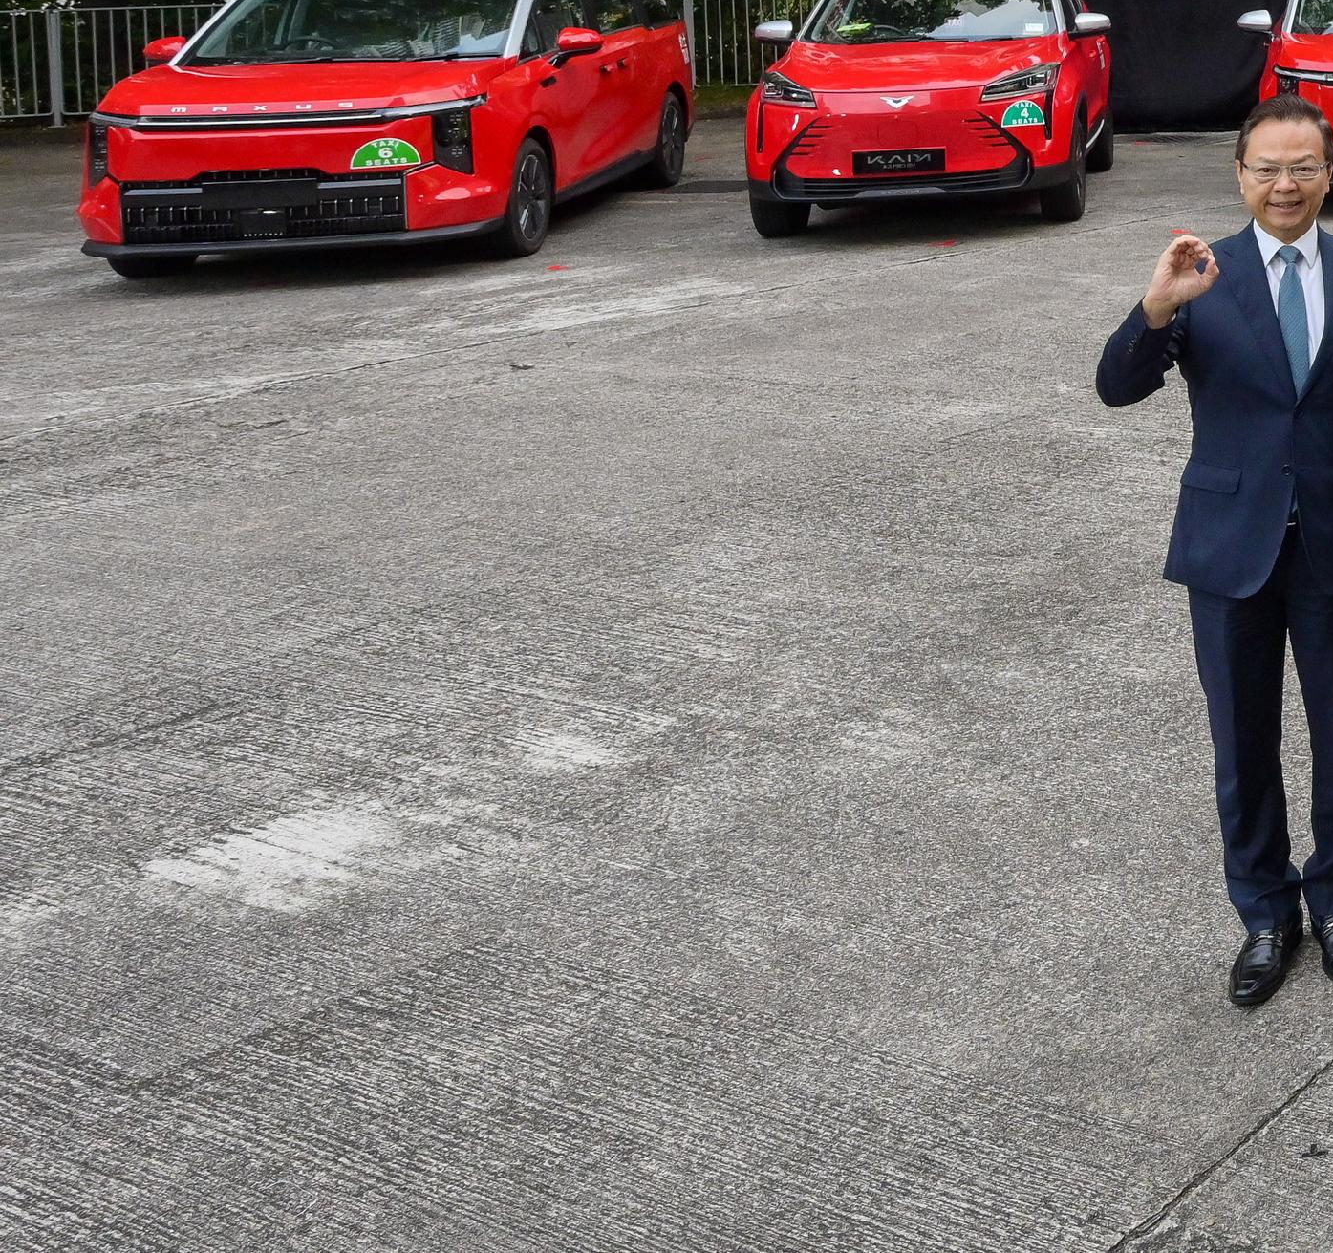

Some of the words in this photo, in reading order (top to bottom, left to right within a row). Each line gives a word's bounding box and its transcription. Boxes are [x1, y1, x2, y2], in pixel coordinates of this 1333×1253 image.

[170, 101, 354, 113] MAXUS
[1020, 107, 1030, 119] 4
[370, 140, 400, 149] TAXI
[378, 147, 393, 158] 6
[365, 157, 408, 166] SEATS
